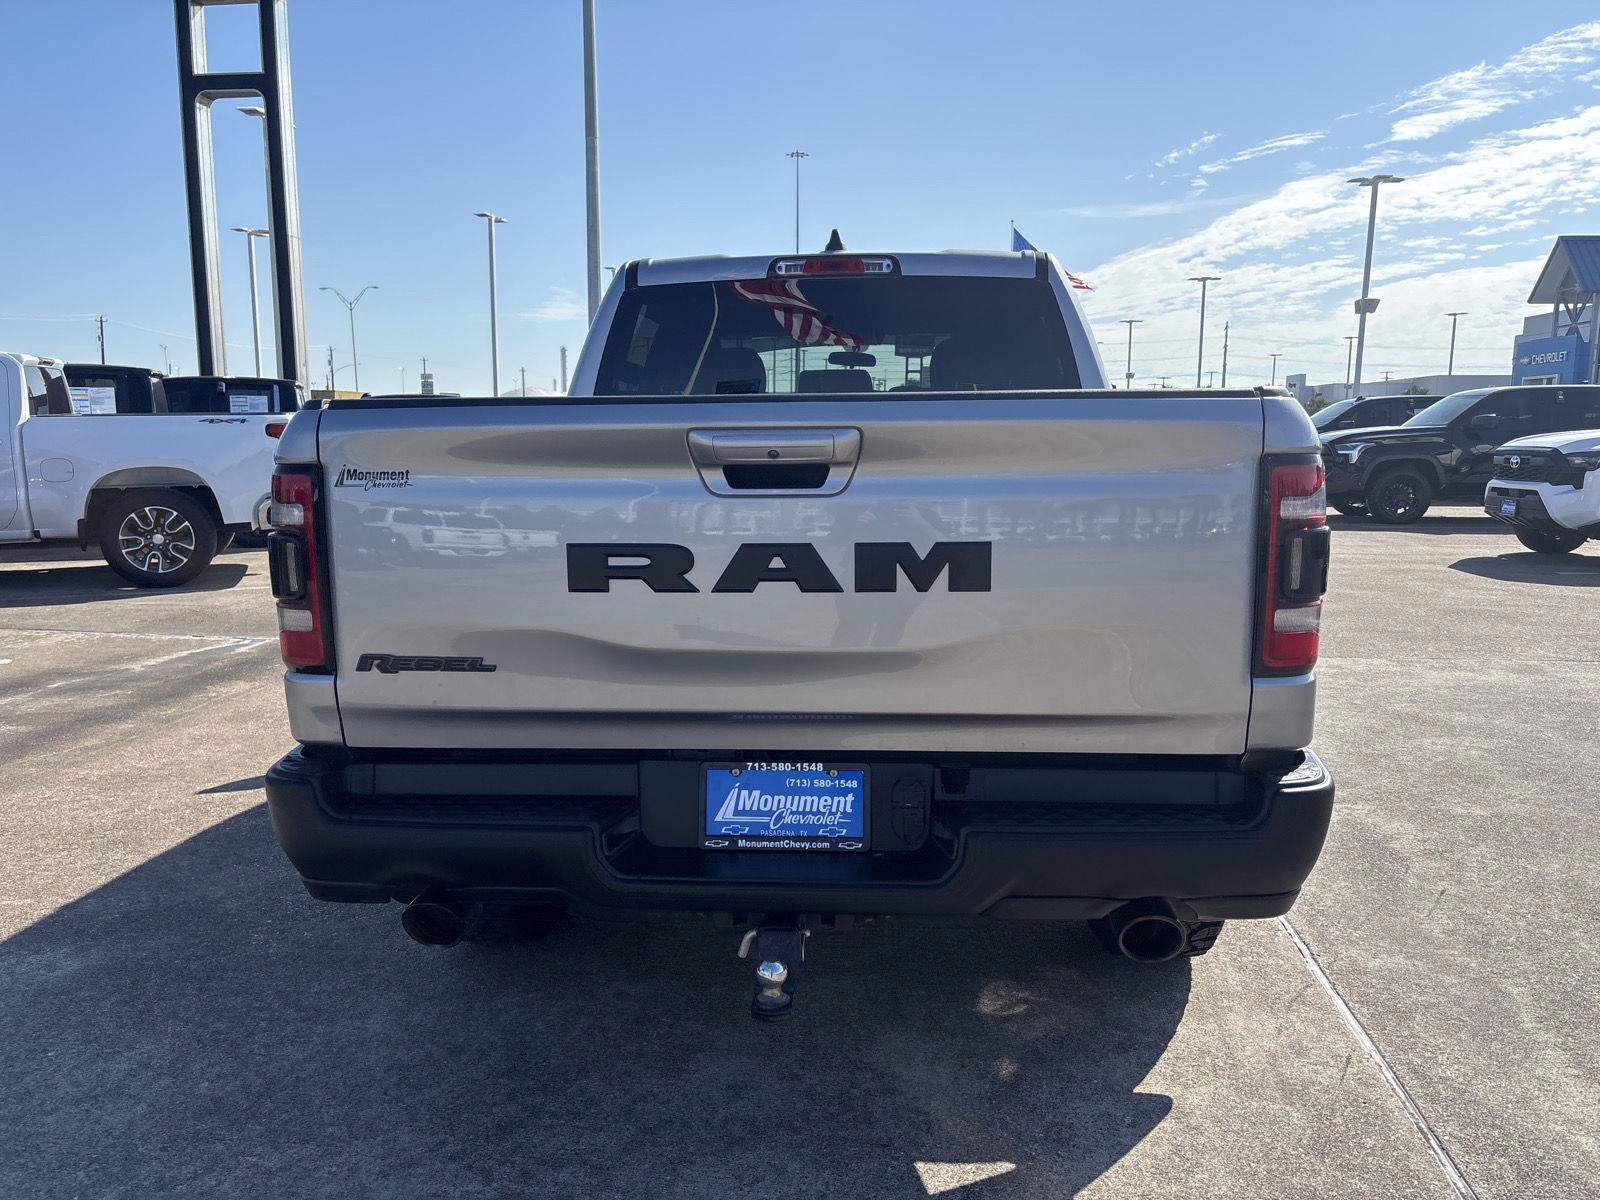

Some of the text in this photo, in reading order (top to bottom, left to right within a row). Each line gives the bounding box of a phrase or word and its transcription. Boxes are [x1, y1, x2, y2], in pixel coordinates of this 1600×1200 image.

[1531, 351, 1567, 365] CHEVROLET
[345, 468, 410, 481] Monument
[364, 479, 413, 491] Chevrolet
[566, 541, 992, 593] RAM
[746, 762, 824, 772] 713-580-1548
[786, 778, 858, 788] (713) 580-1548
[738, 789, 855, 813] Monument
[770, 806, 851, 829] Chevrolet
[738, 839, 830, 850] MonumentChevy.com
